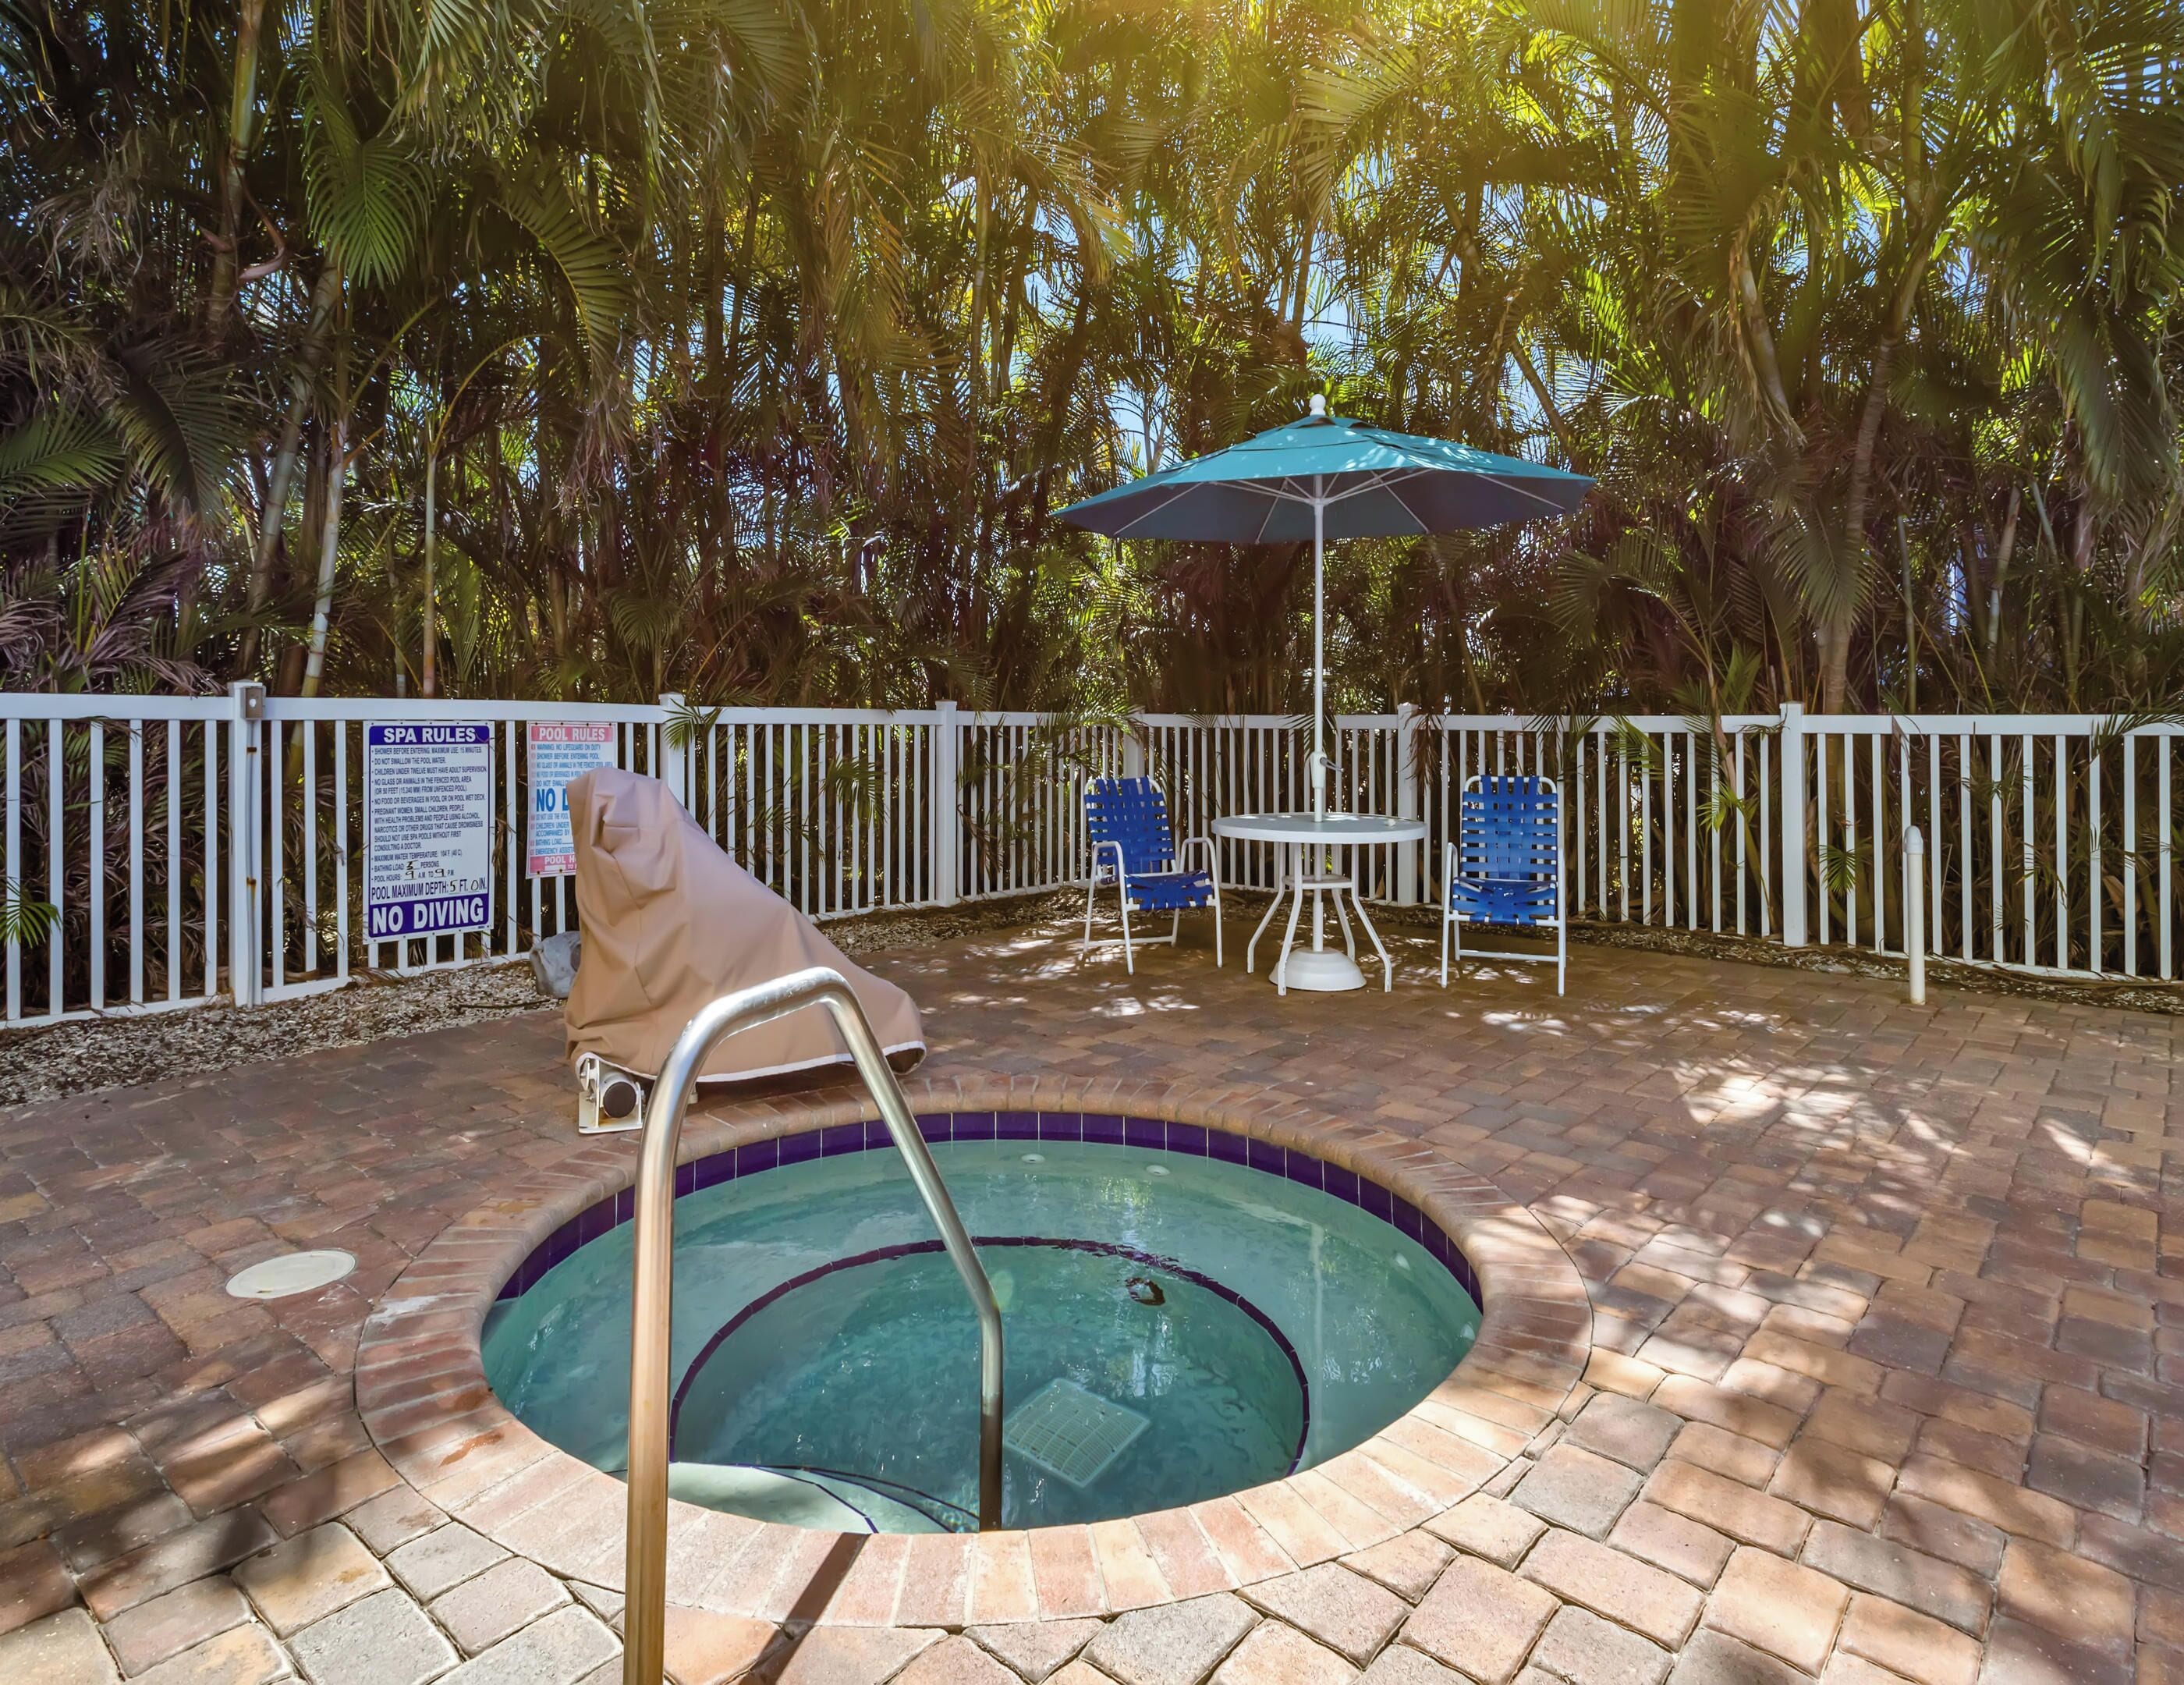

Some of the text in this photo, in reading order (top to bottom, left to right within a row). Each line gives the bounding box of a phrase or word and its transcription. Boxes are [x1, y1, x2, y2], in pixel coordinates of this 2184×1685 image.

[384, 728, 476, 743] SPA RULES
[539, 728, 604, 740] POOL RULES
[537, 788, 555, 812] NO
[405, 871, 414, 879] 9
[371, 886, 390, 900] POOL
[392, 883, 424, 897] MAXIMUM
[449, 880, 459, 892] 5
[373, 897, 484, 934] NO DIVING
